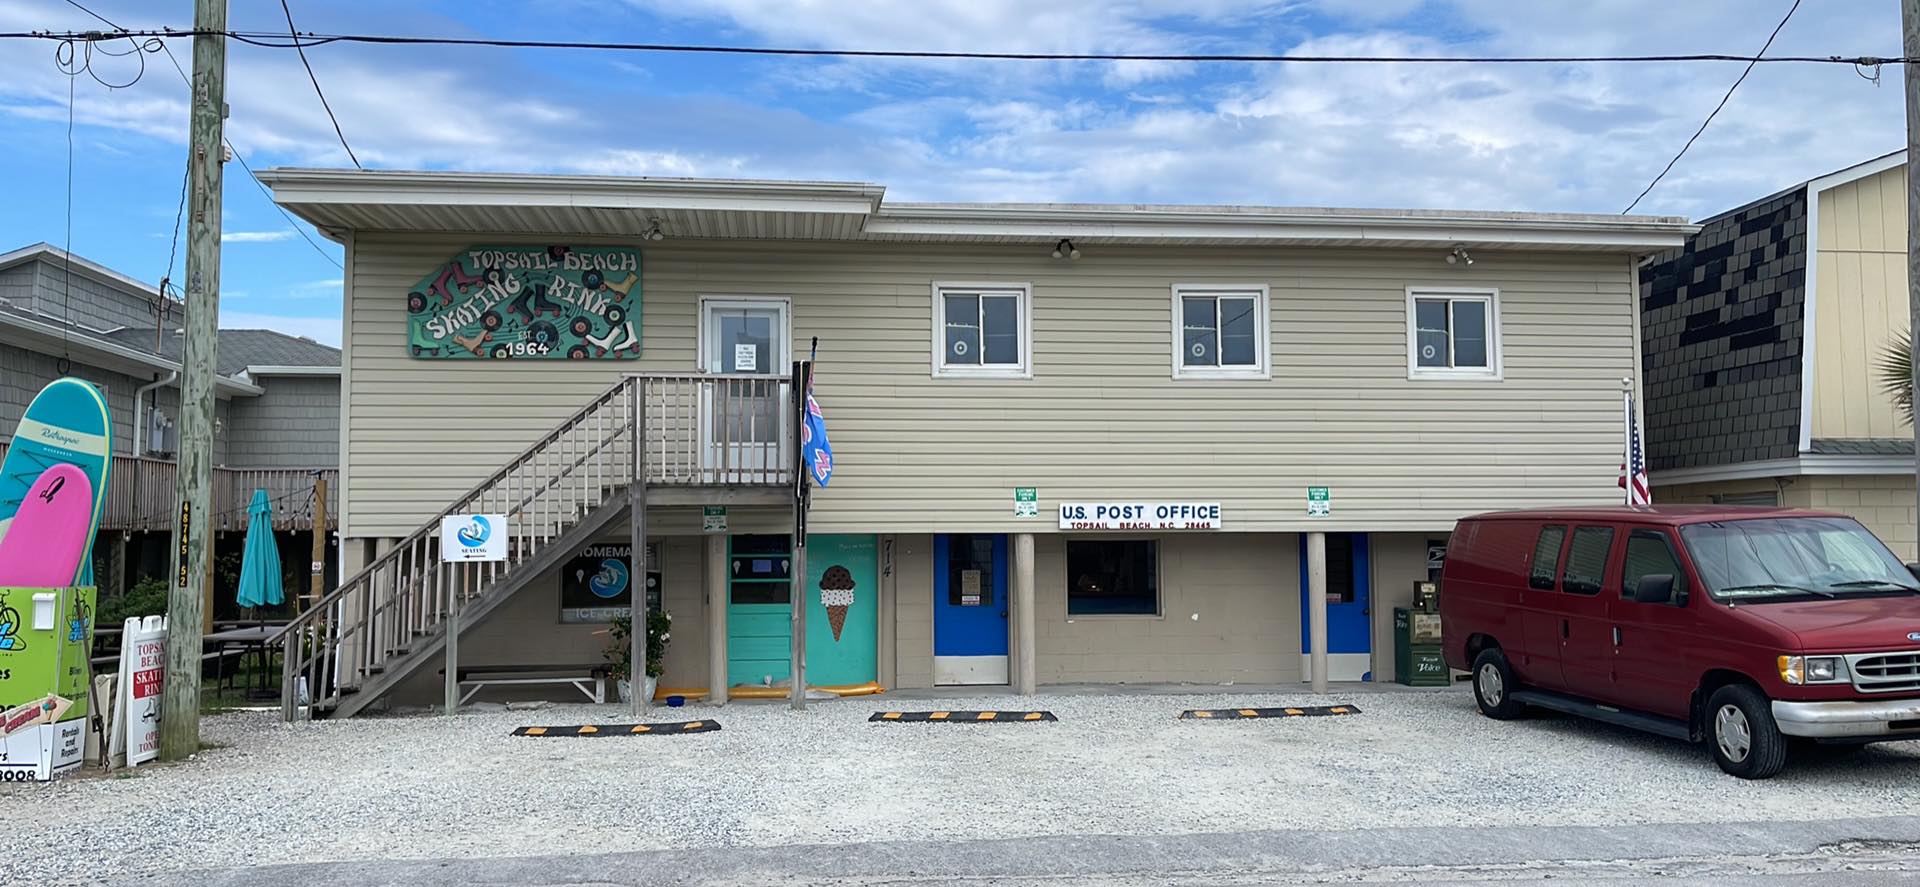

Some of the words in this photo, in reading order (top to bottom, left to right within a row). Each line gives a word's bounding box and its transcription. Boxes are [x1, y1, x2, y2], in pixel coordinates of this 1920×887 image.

[469, 250, 558, 271] TOPSAIL
[563, 251, 638, 272] BEACH
[425, 272, 521, 340] SKATING
[547, 274, 612, 316] RINK
[505, 341, 550, 356] 1964
[1062, 505, 1088, 520] U.S.
[1096, 505, 1144, 520] POST
[1156, 505, 1219, 520] OFFICE
[181, 501, 190, 555] 48745
[578, 546, 651, 558] OMEMAE
[180, 565, 188, 586] 52
[575, 607, 597, 618] ICE
[137, 642, 165, 656] TOPSA
[141, 654, 165, 668] BEAC
[136, 669, 163, 685] SKATI
[144, 683, 163, 697] RIN
[145, 730, 160, 742] OPE
